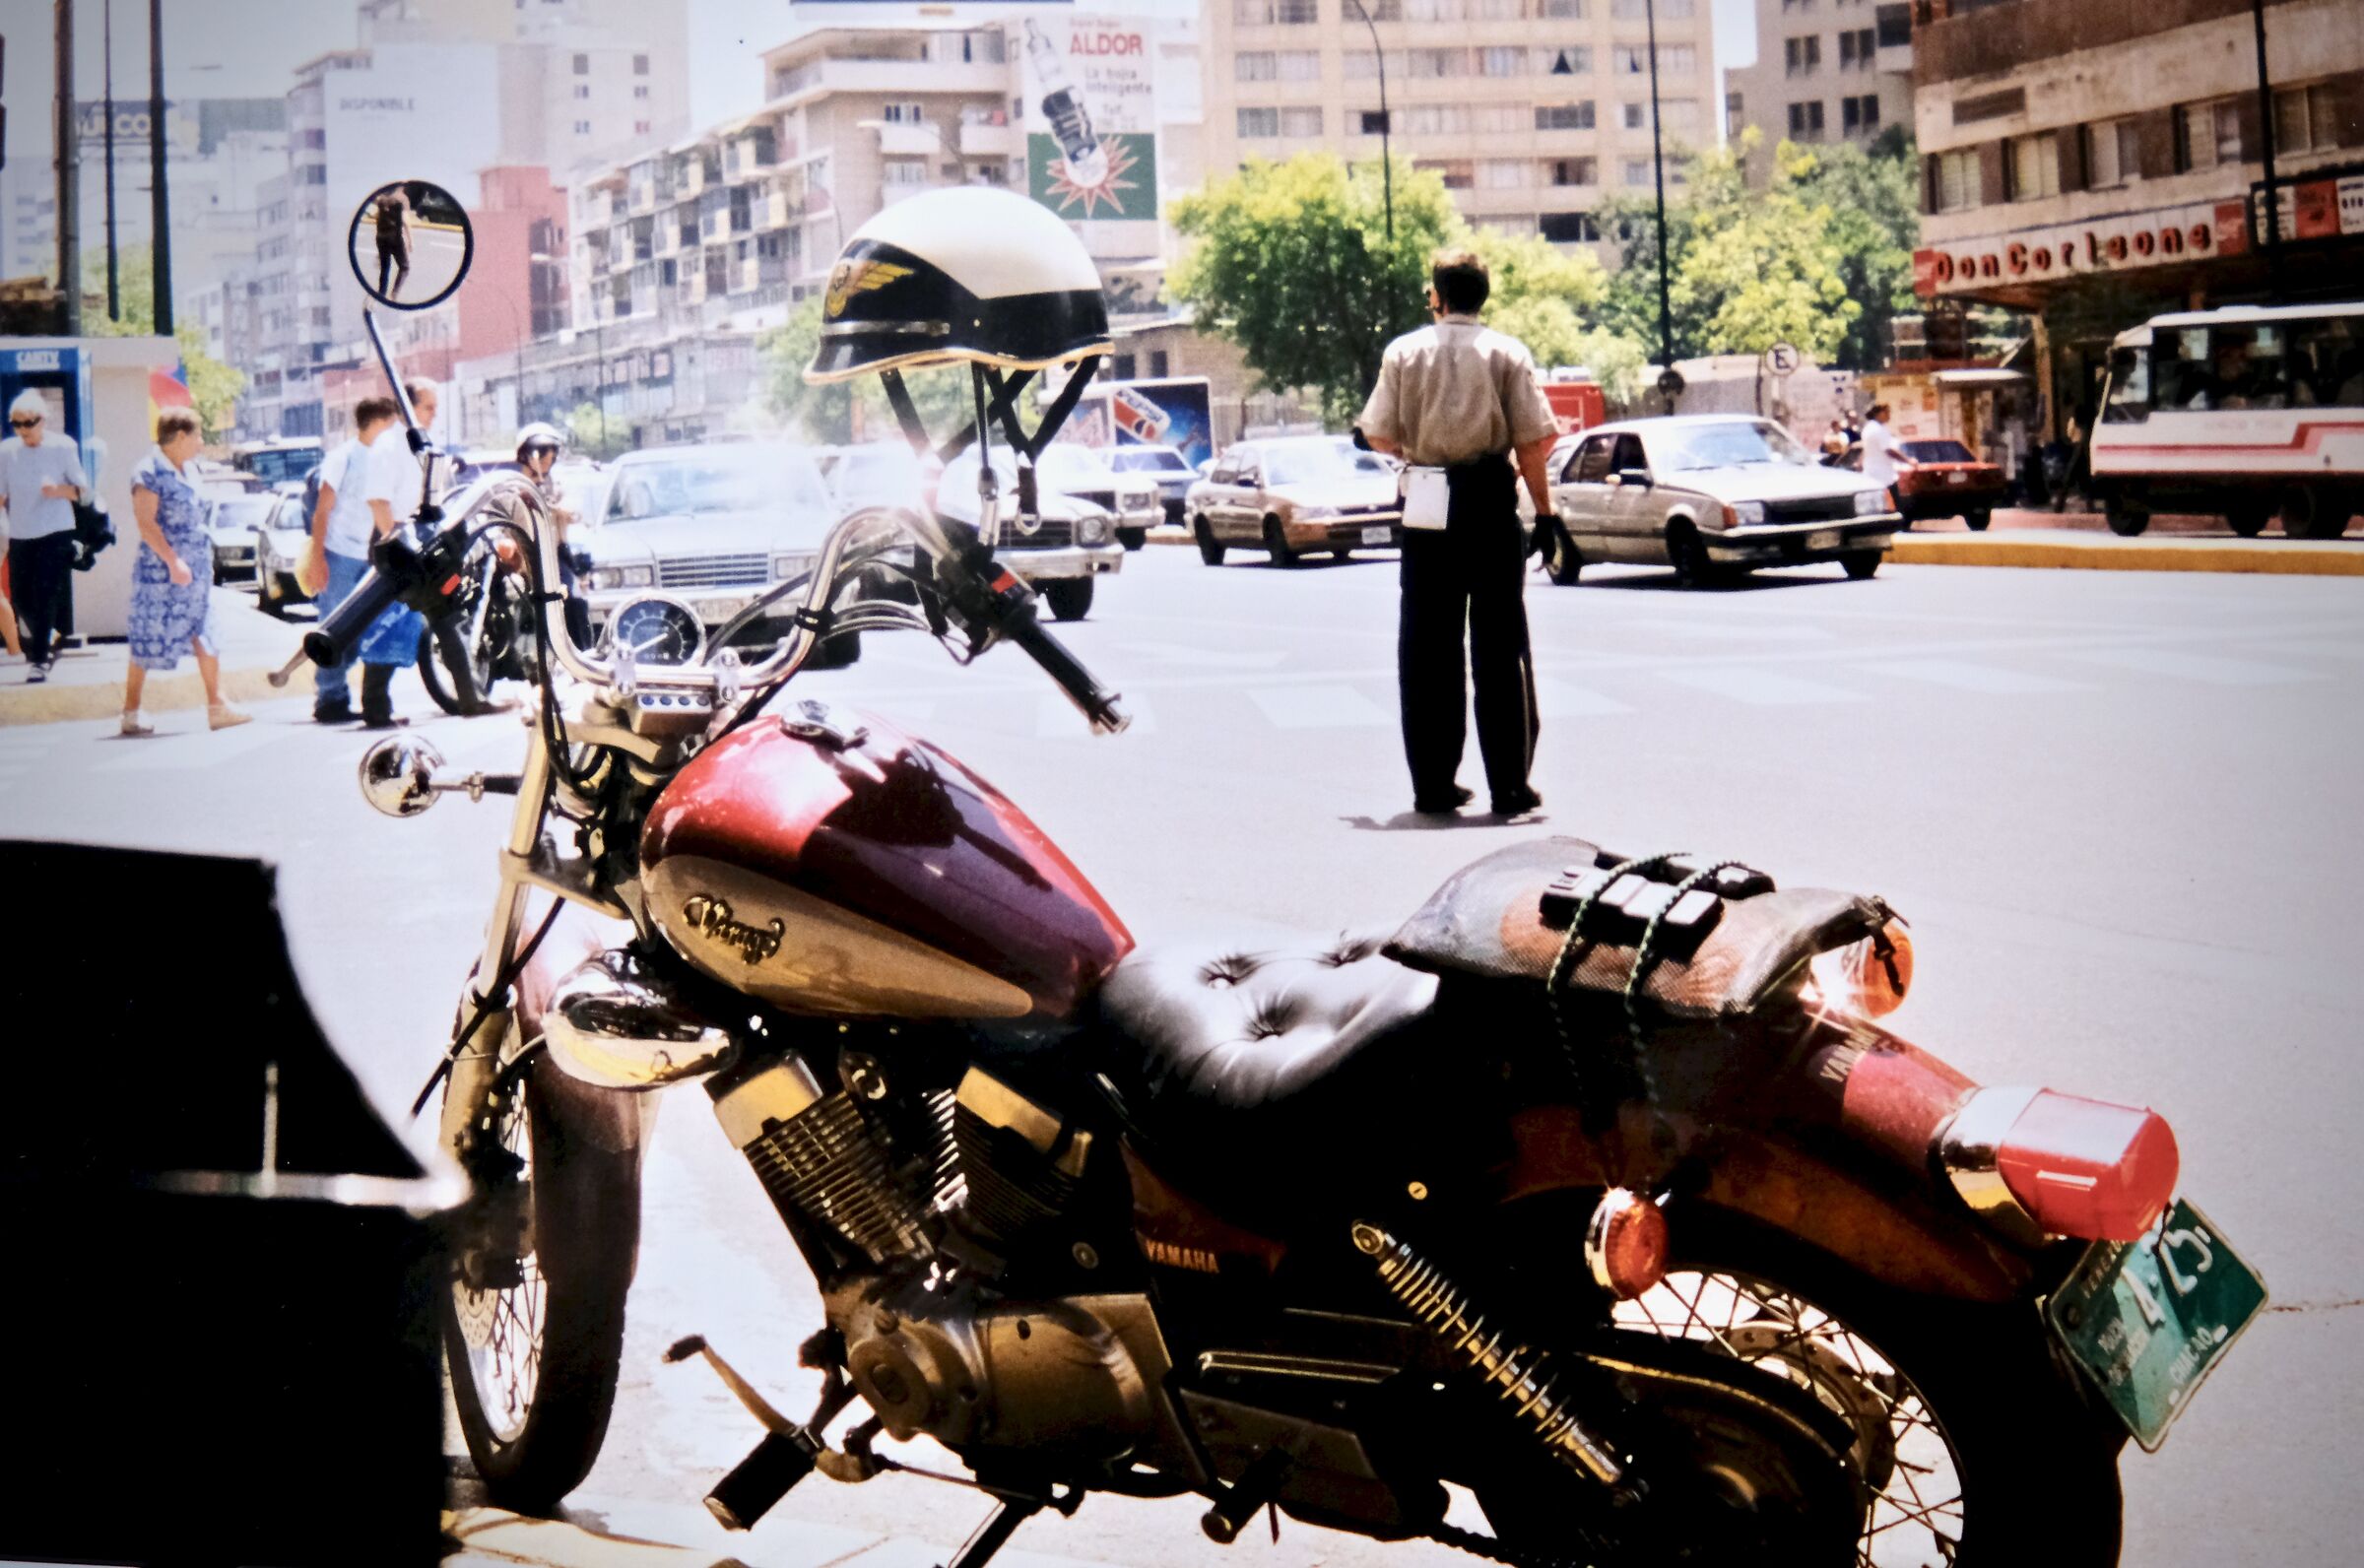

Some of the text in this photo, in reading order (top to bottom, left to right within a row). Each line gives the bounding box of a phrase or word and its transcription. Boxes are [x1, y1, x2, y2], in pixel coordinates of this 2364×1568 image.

[1069, 33, 1144, 57] ALDOR
[339, 97, 416, 111] DISPONIBLE
[1773, 349, 1791, 370] E
[1145, 1238, 1220, 1274] YAMAHA
